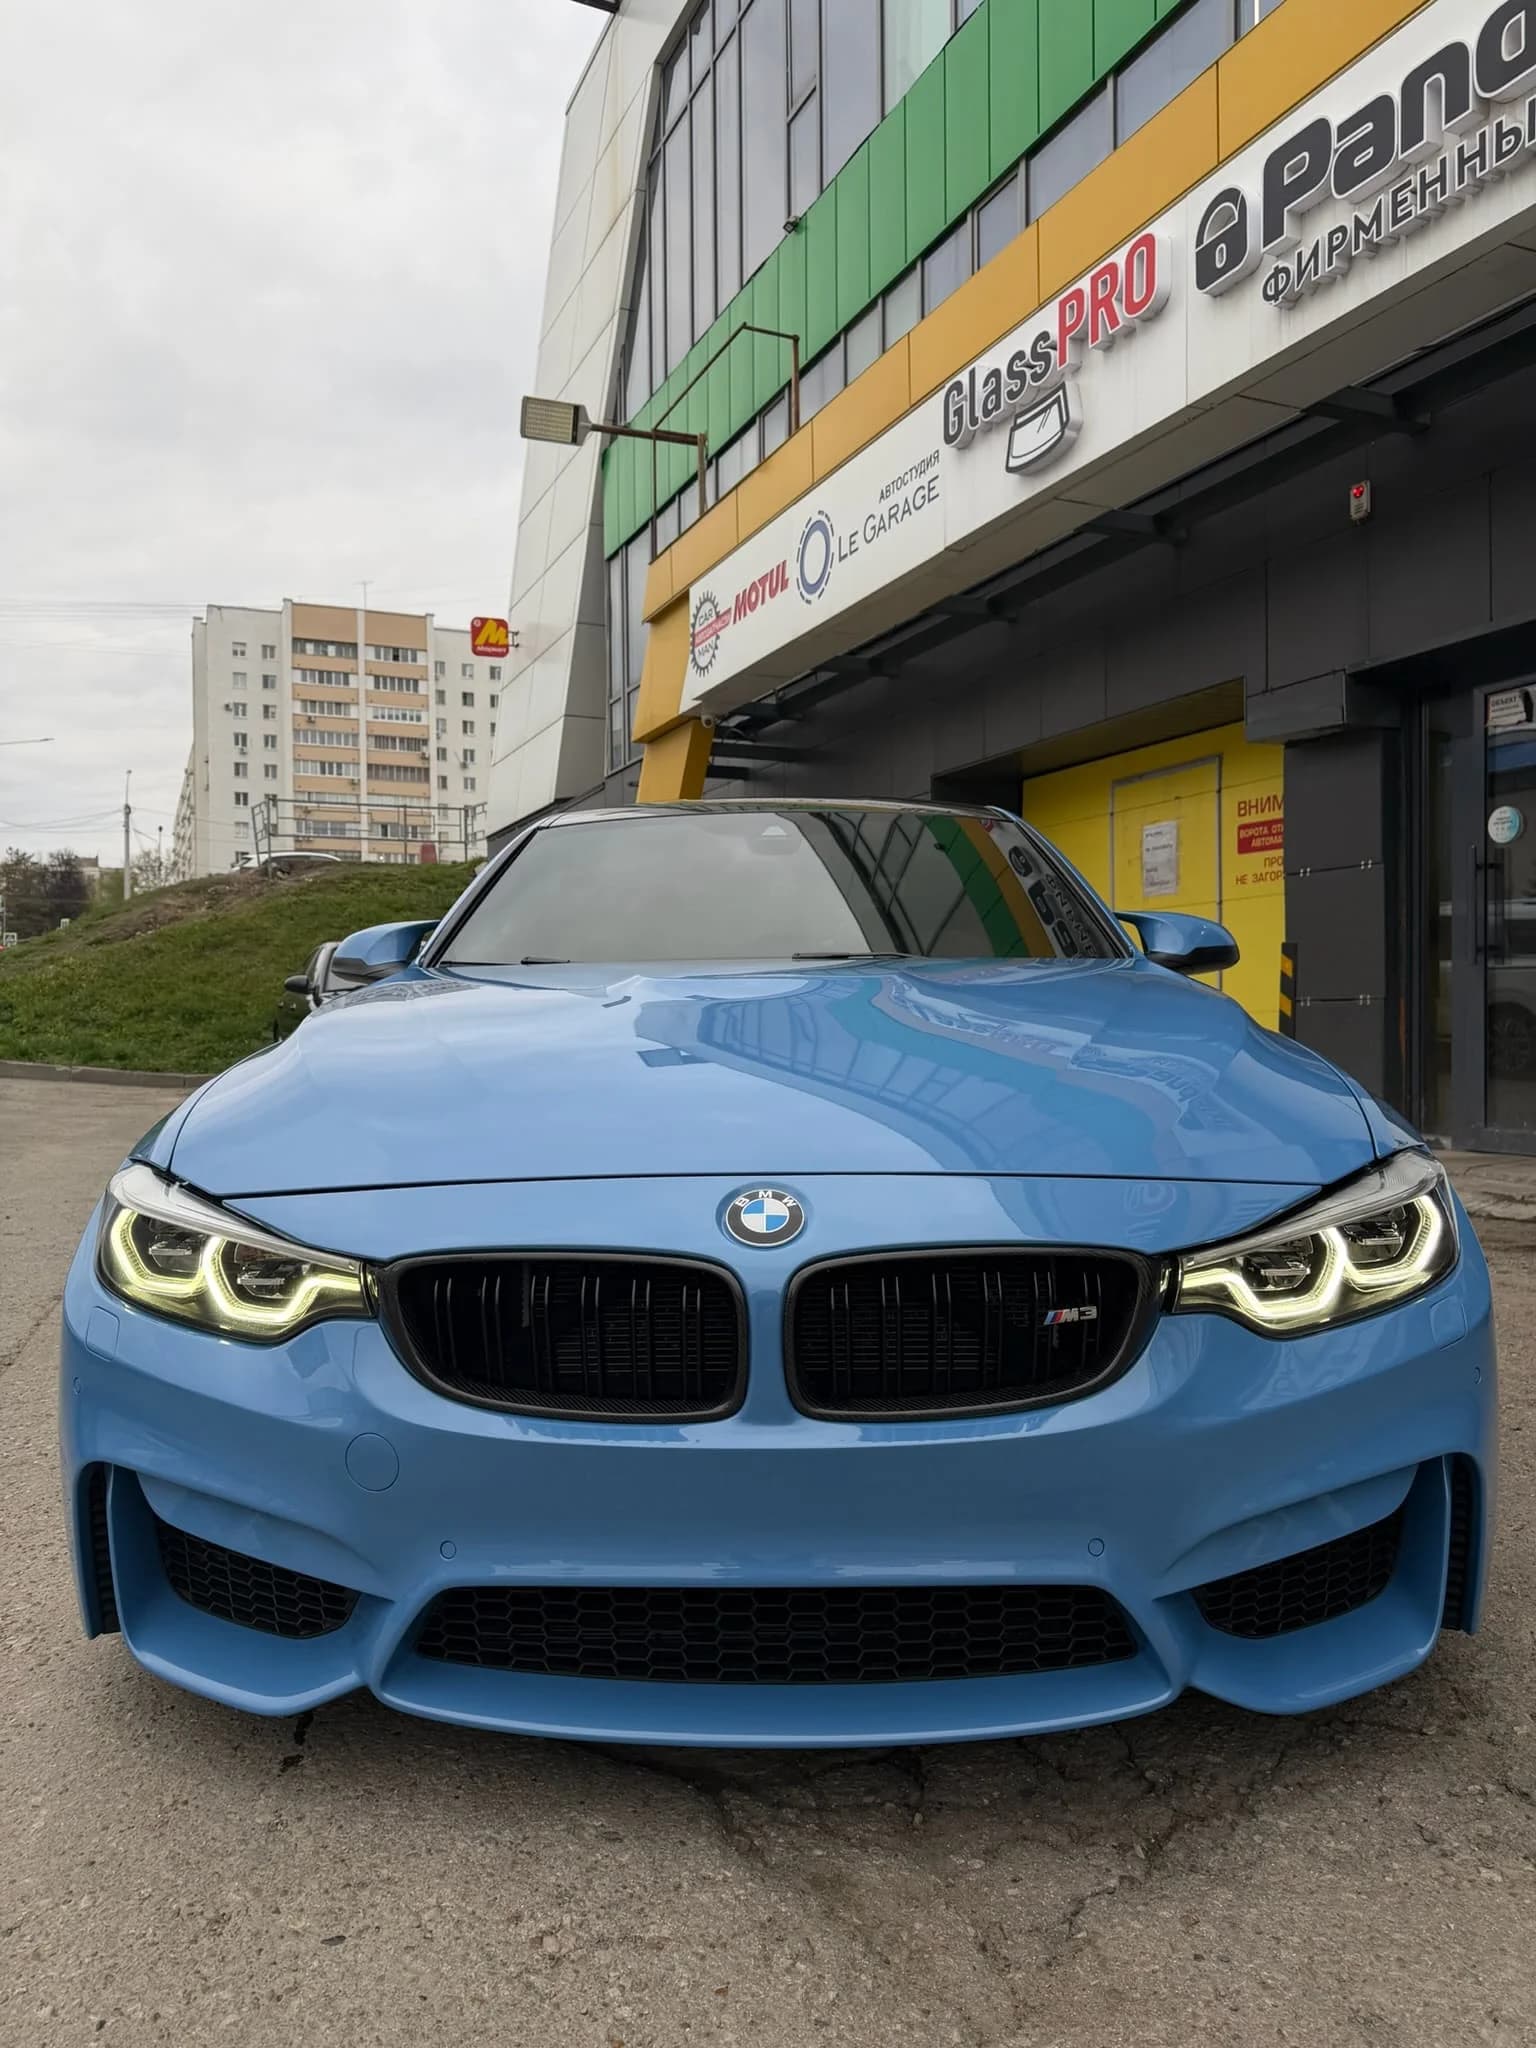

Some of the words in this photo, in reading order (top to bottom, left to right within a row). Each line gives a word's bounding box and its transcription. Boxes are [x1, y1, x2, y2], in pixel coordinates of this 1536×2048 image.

[944, 233, 1156, 445] GlassPRO
[879, 449, 939, 503] АВТОСТУДИЯ
[838, 530, 859, 563] LE
[863, 475, 939, 544] GARAGE
[733, 560, 789, 624] MOTUL
[699, 608, 714, 626] CAR
[1235, 873, 1248, 885] НЕ
[735, 1190, 797, 1208] BMW
[1057, 1305, 1097, 1323] M3
